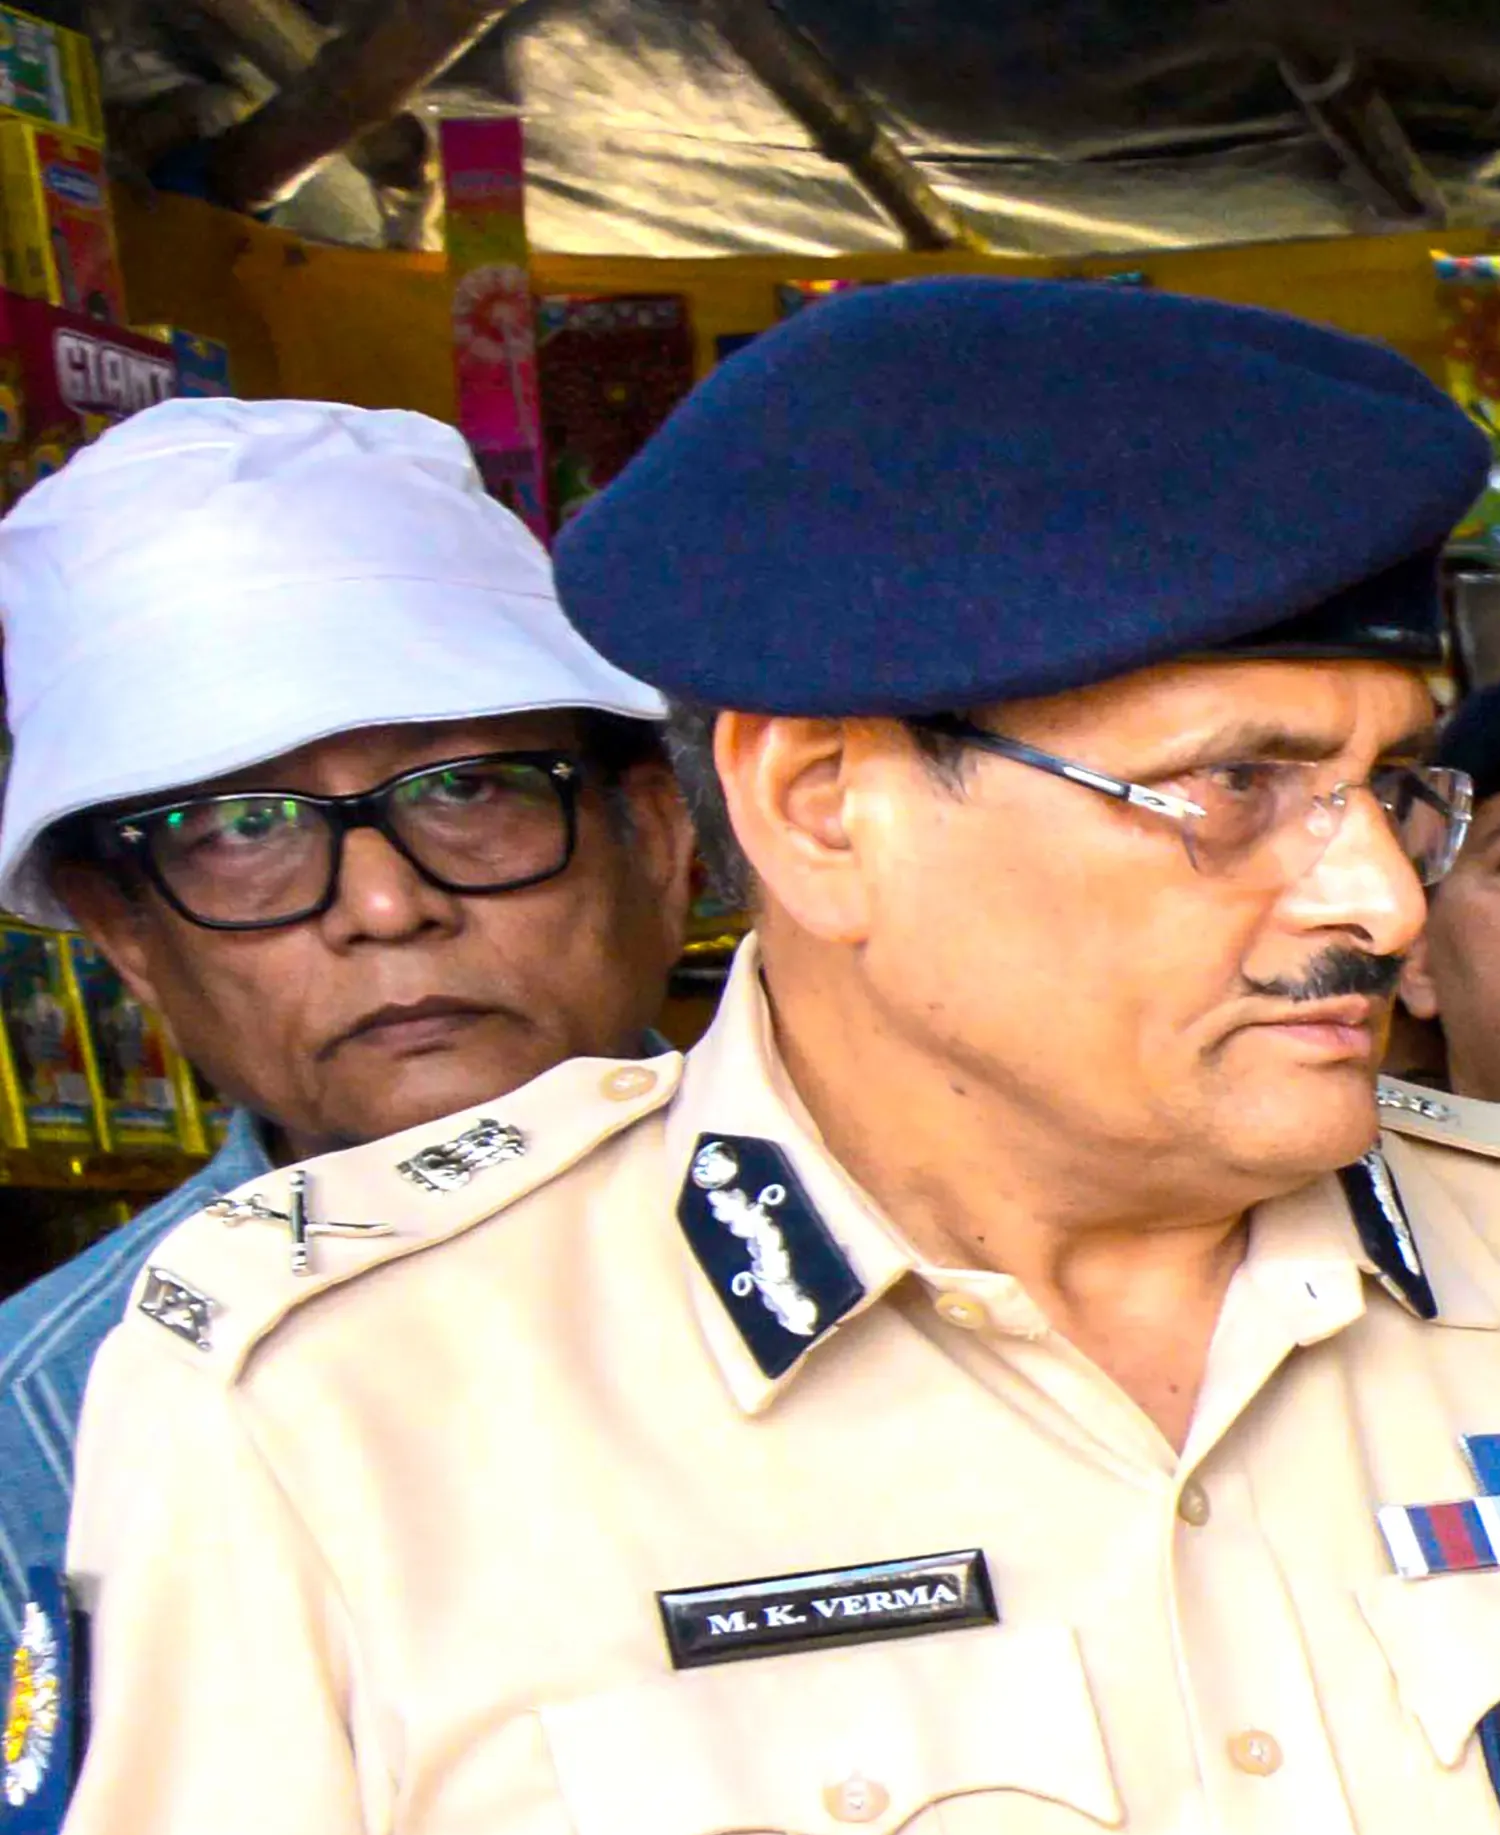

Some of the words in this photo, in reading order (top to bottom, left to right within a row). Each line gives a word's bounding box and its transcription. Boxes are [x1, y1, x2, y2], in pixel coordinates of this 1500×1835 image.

[707, 1610, 757, 1636] M.
[762, 1604, 806, 1627] K.
[809, 1583, 960, 1620] VERMA
